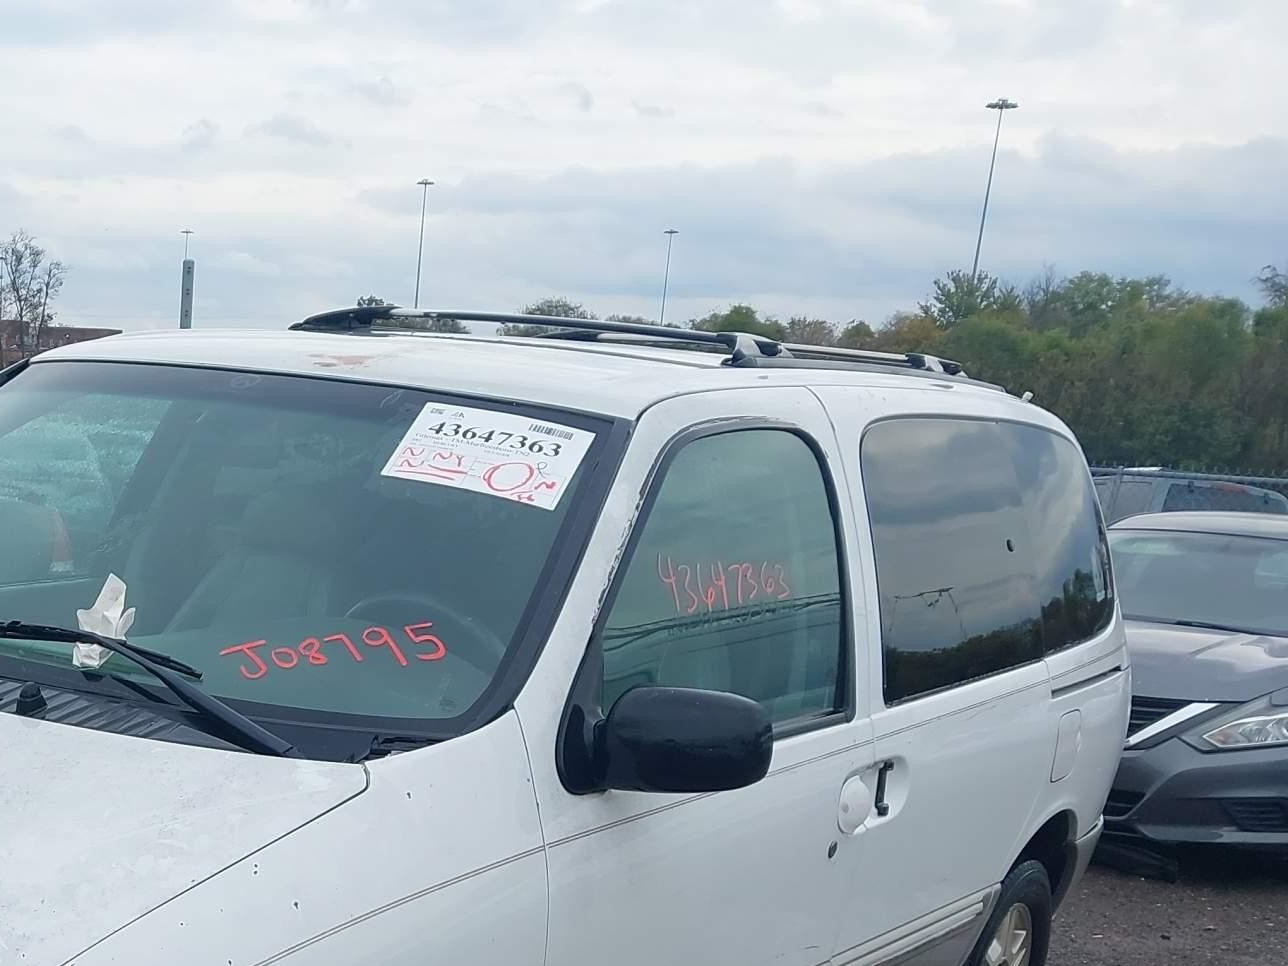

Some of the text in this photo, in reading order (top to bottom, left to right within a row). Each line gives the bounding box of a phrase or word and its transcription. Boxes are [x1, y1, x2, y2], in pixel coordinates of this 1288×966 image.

[428, 421, 562, 457] 43647363
[657, 552, 791, 612] 43647363
[219, 622, 447, 679] J08795
